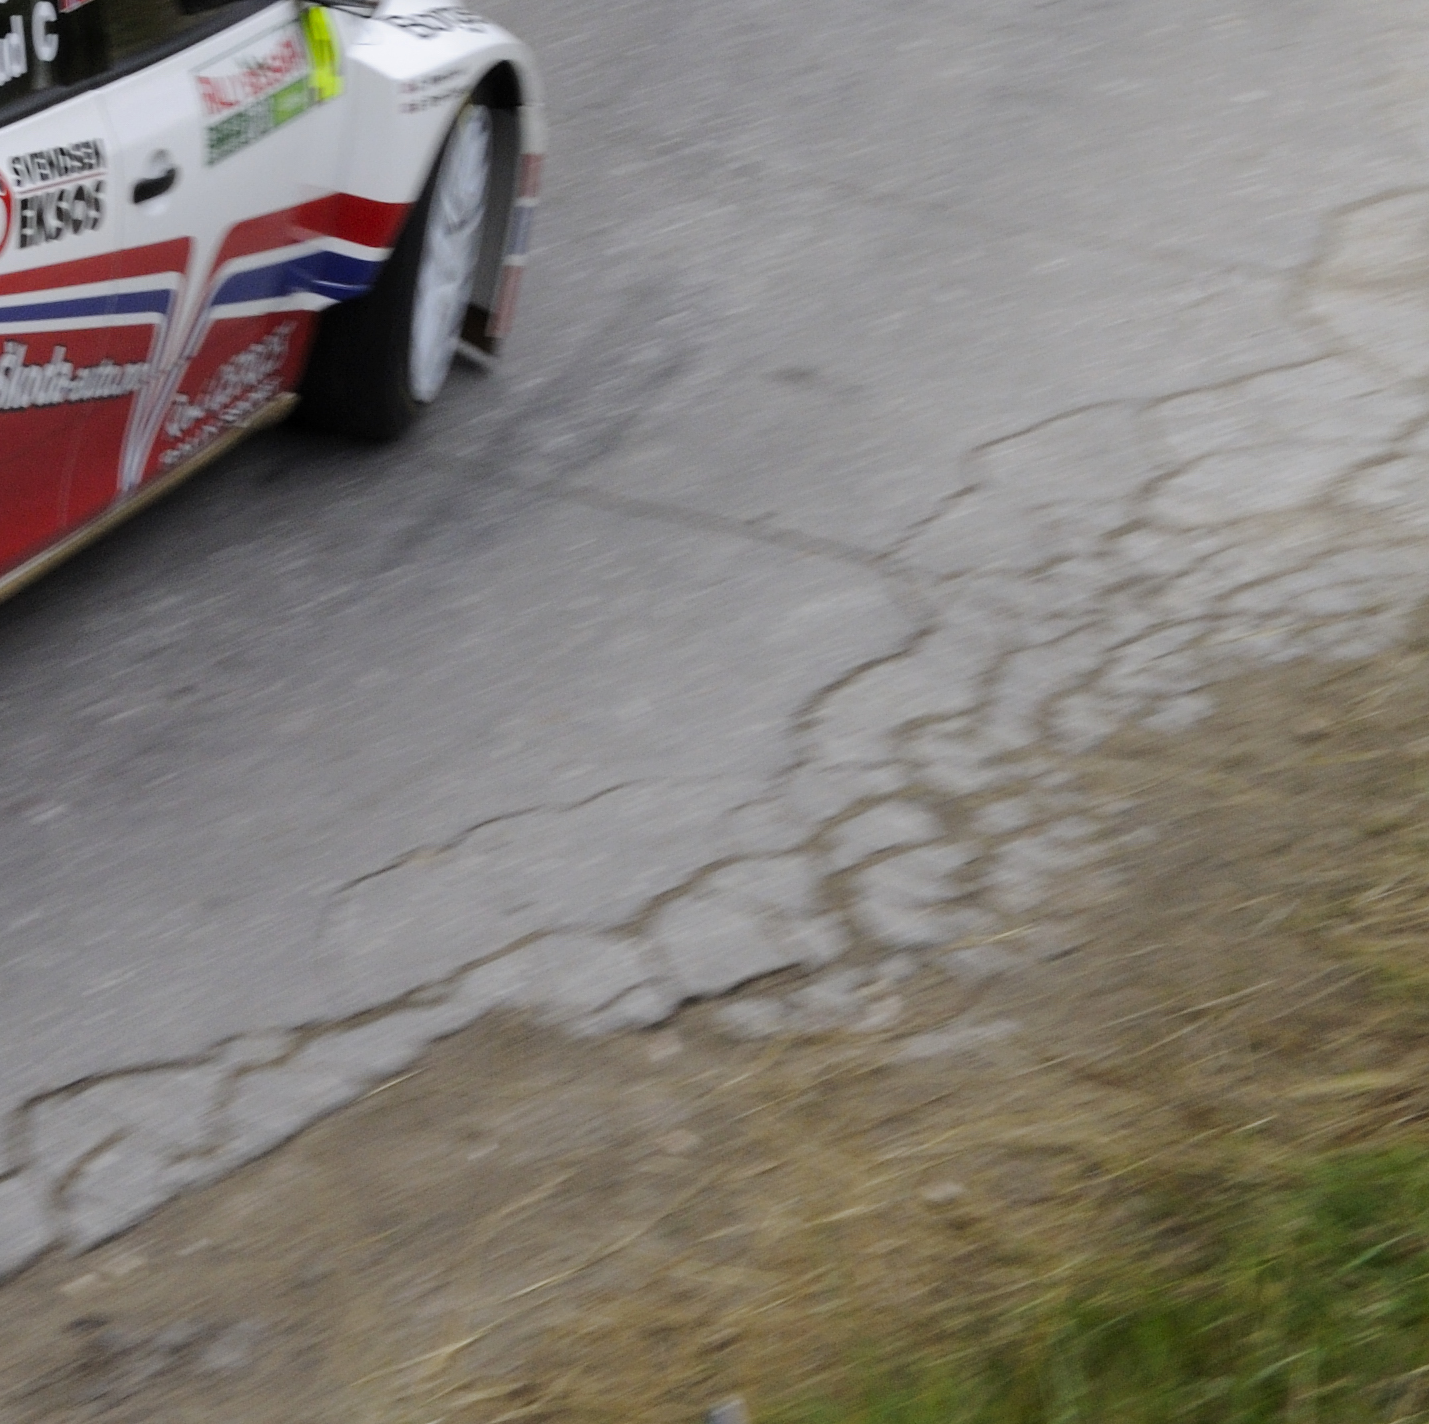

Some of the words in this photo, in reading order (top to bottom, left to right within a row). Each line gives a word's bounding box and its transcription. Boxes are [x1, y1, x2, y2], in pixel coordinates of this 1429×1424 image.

[31, 0, 60, 62] C
[11, 137, 107, 188] SVENDSEN
[16, 179, 107, 249] EKSOS
